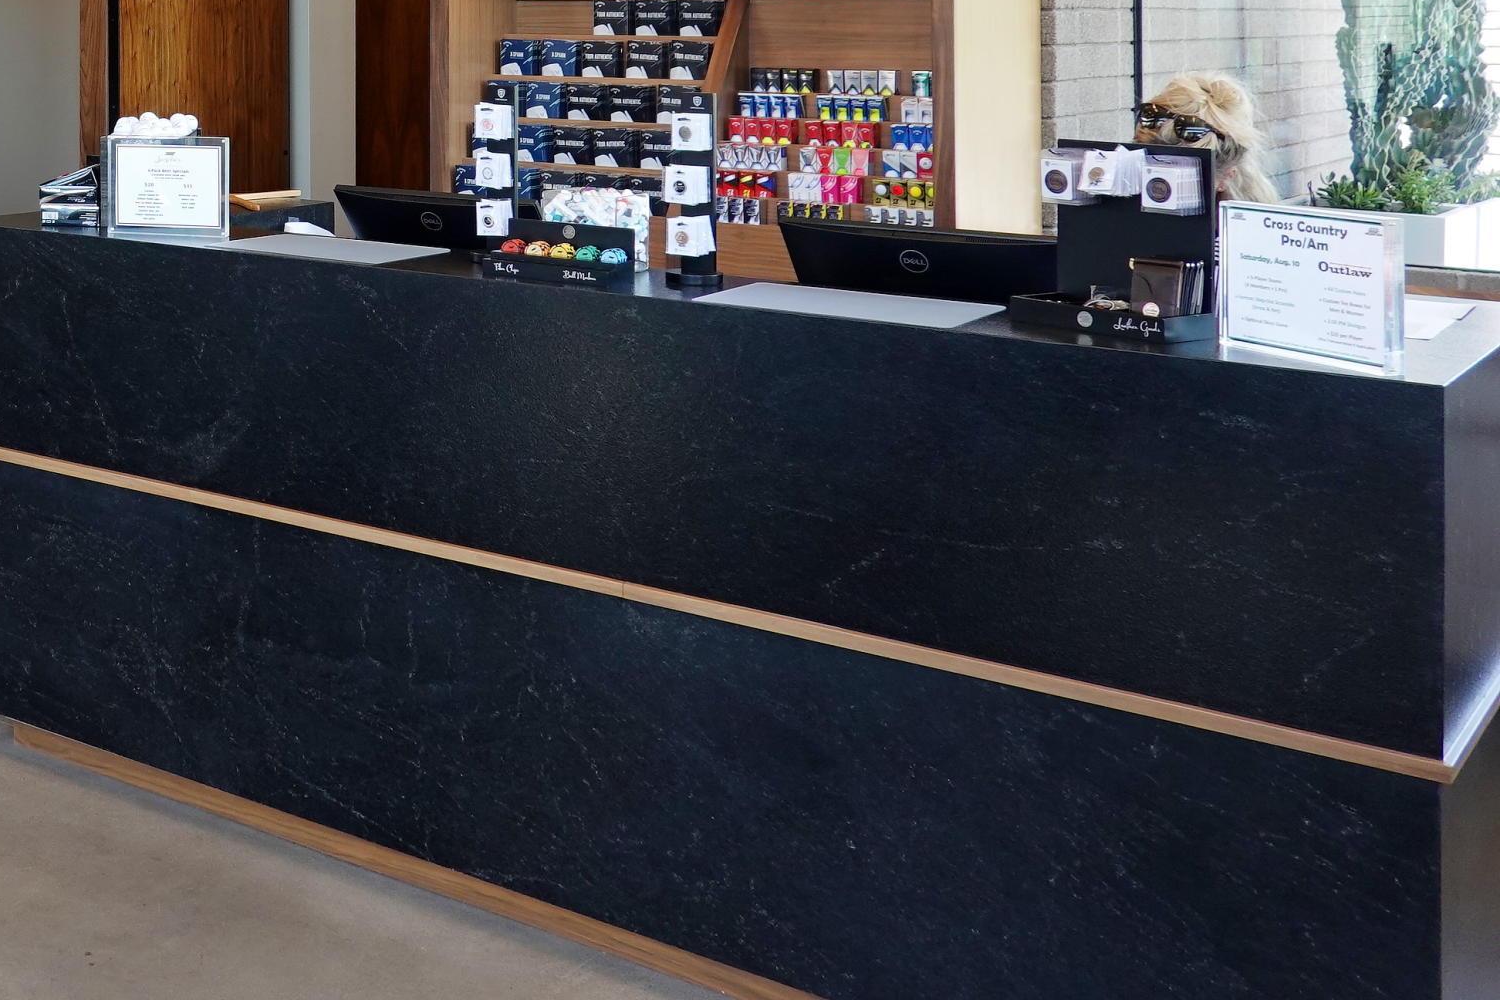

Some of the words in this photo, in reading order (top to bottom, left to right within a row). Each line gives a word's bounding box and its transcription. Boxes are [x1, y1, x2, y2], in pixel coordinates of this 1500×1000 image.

[1263, 216, 1293, 231] Cross
[1296, 220, 1348, 239] Country
[1281, 234, 1329, 251] Pro/Am
[902, 257, 927, 266] DELL
[1318, 260, 1373, 278] Outlaw
